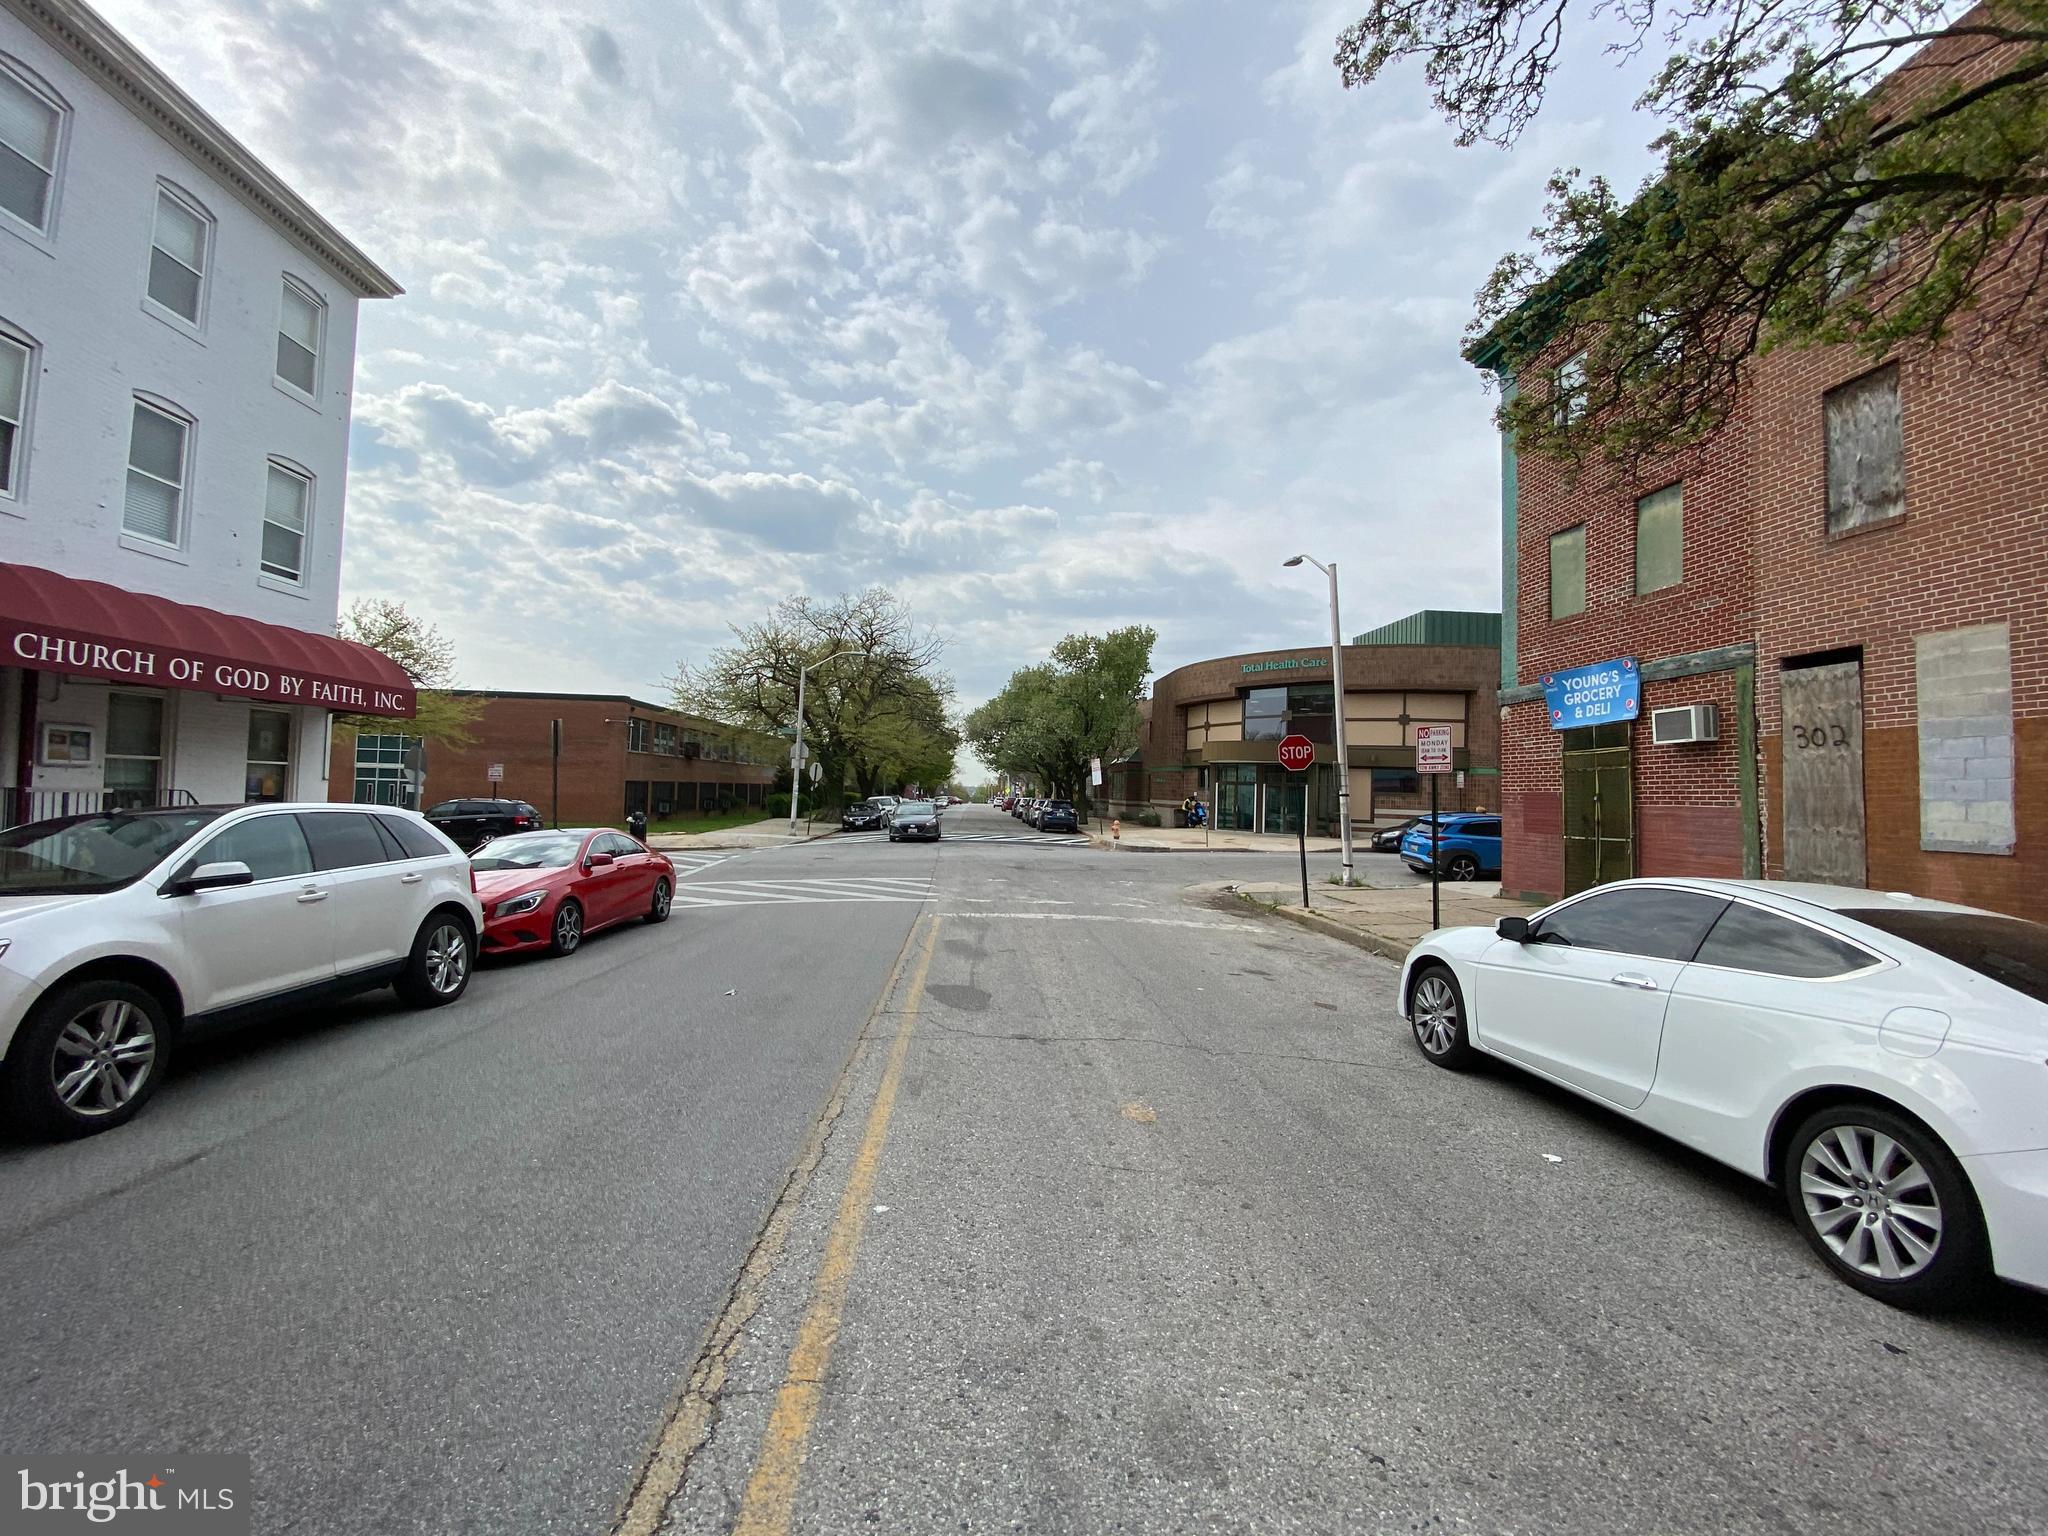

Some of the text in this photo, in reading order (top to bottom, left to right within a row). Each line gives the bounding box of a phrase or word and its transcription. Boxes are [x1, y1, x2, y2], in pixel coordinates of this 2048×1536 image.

[14, 633, 405, 711] CHURCH OF GOD BY FAITH, INC.
[1241, 663, 1263, 673] Total
[1264, 659, 1298, 671] Health
[1562, 670, 1619, 690] YOUNG'S
[1564, 685, 1621, 705] GROCERY
[1575, 702, 1610, 718] & DELI
[1419, 728, 1449, 738] NO PARKING
[1793, 725, 1850, 748] 302
[1281, 746, 1311, 759] STOP
